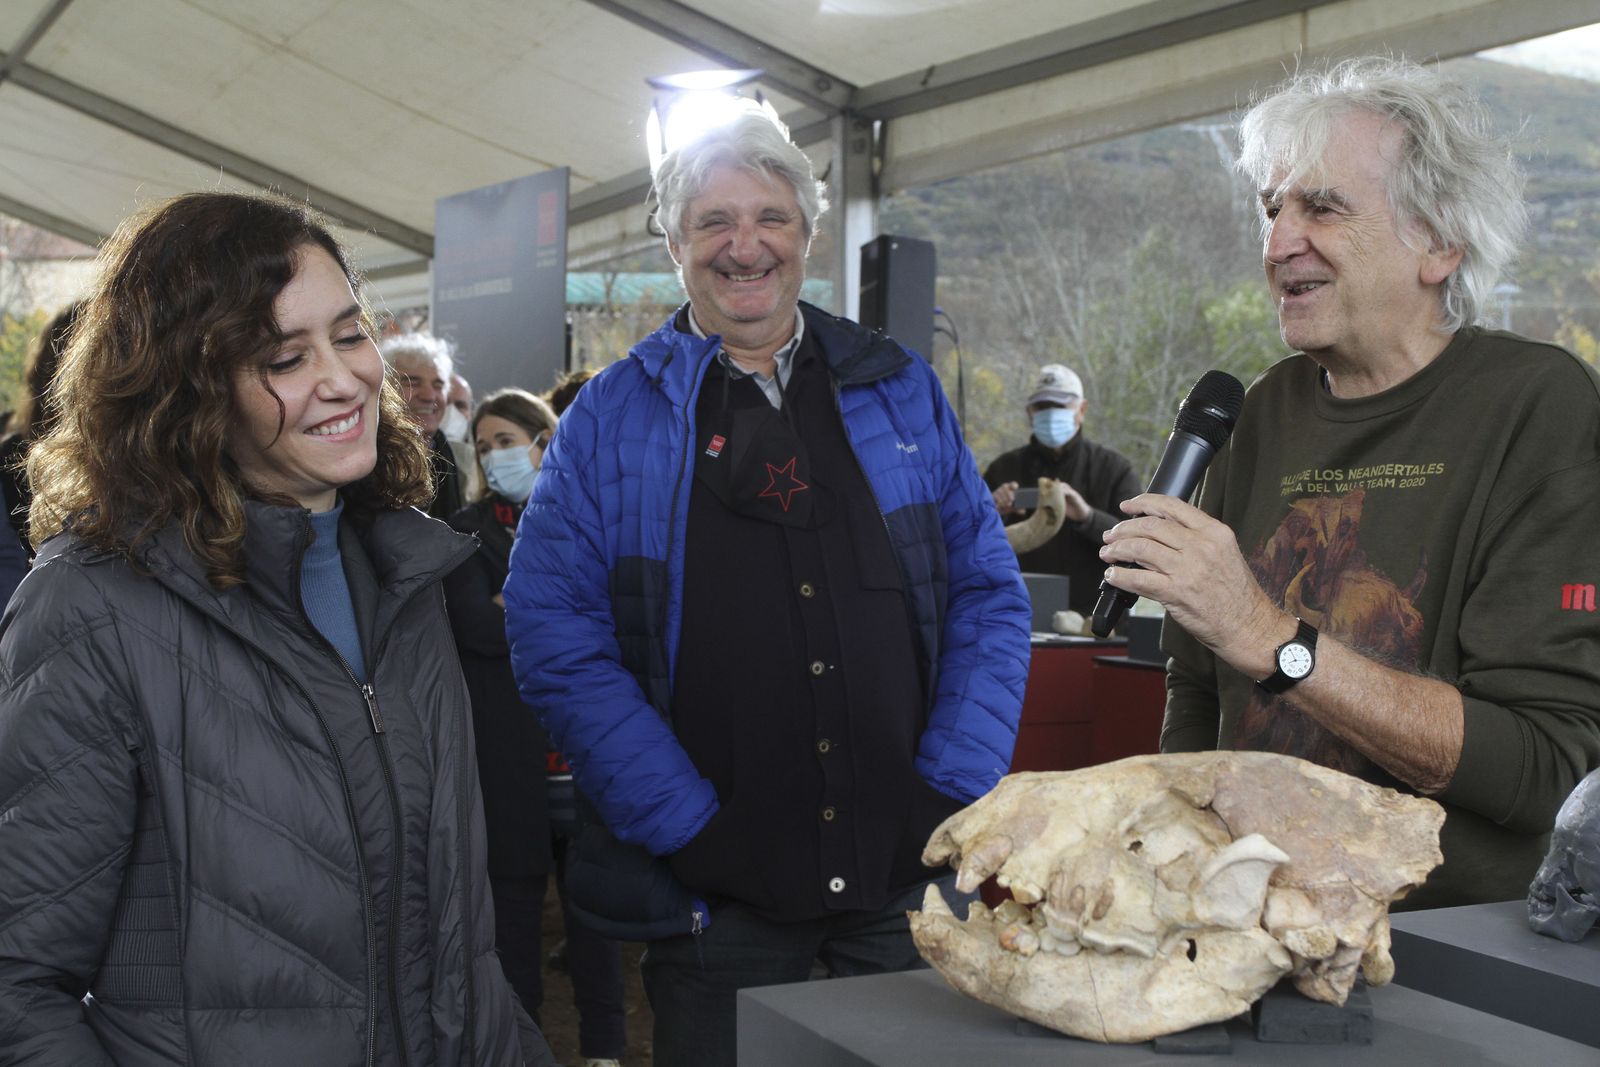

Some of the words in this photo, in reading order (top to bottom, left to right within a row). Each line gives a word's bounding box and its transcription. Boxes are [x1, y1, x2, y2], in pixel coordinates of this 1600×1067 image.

[1314, 469, 1344, 481] LOS
[1348, 463, 1445, 481] NEANDERTALES
[1307, 482, 1331, 493] DEL
[1367, 478, 1395, 490] TEAM
[1399, 477, 1426, 489] 2020
